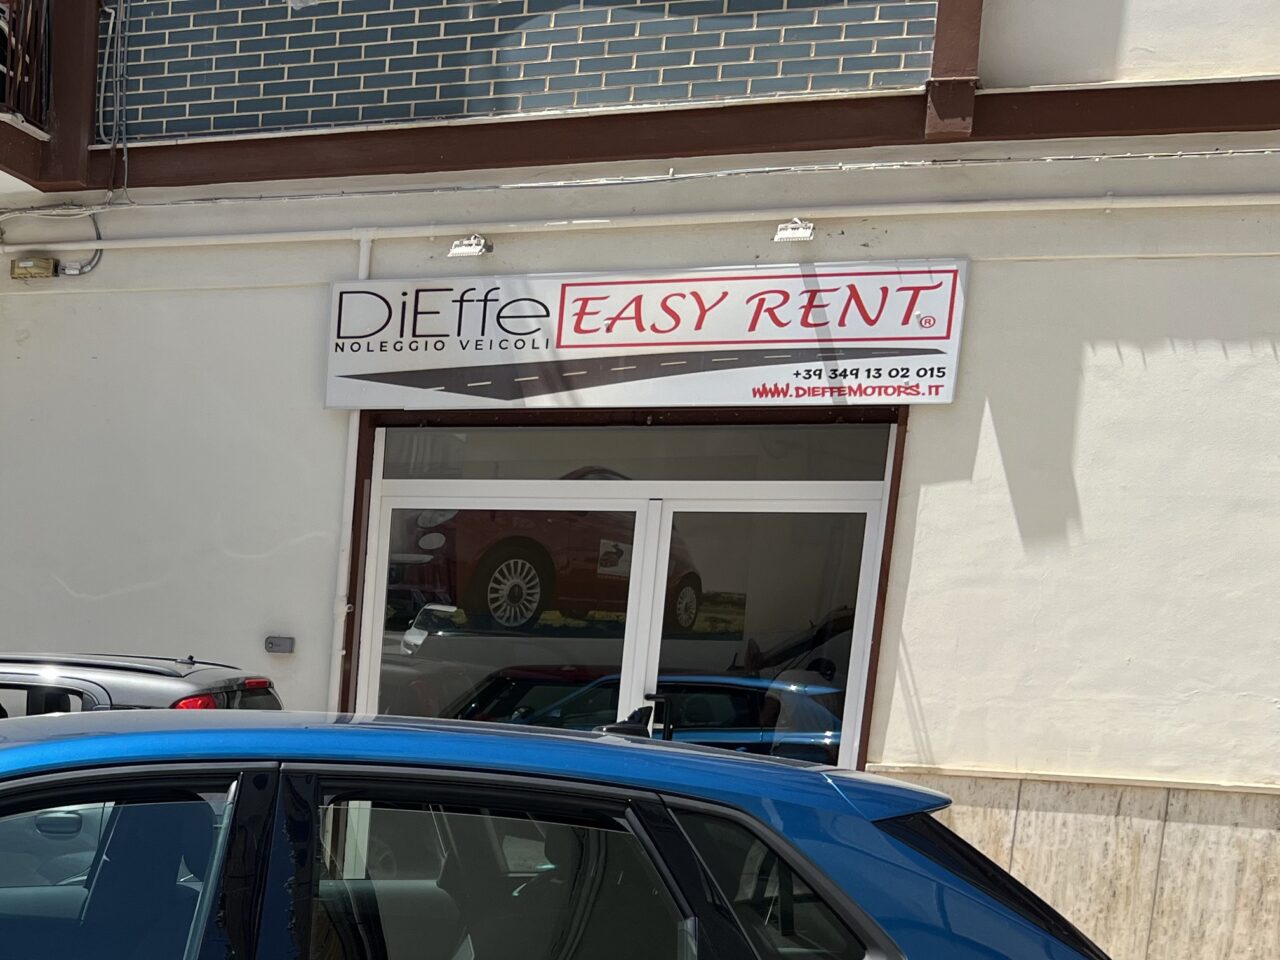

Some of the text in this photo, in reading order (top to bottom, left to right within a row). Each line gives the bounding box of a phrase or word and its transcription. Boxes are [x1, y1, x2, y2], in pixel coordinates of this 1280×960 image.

[337, 287, 550, 339] DiEffe
[572, 281, 943, 334] EASY RENT
[335, 338, 549, 353] NOLEGGIO VEICOLI
[793, 367, 946, 380] +39 349 13 02 015
